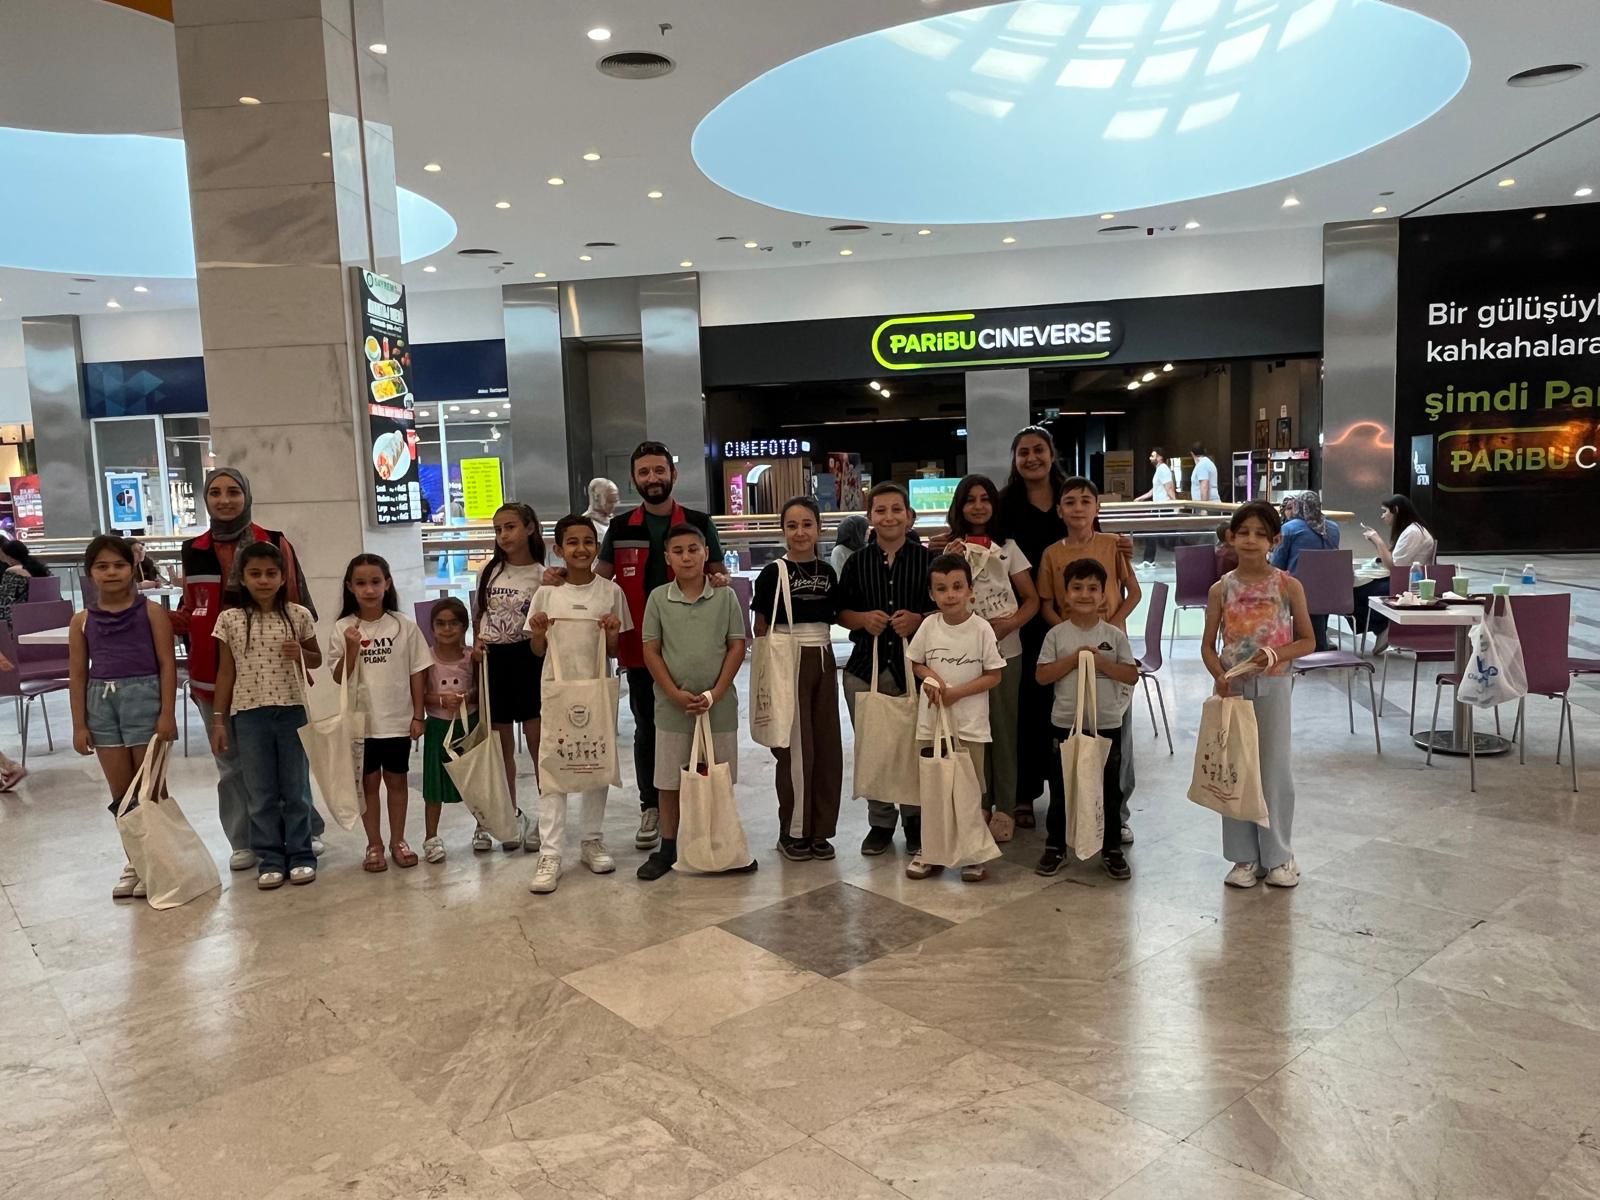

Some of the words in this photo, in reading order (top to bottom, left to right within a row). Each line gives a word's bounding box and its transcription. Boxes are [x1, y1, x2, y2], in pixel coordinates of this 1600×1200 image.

[1428, 301, 1468, 326] Bir
[978, 321, 1111, 349] CINEVERSE
[1427, 334, 1600, 362] kahkahalara
[1425, 382, 1528, 421] şimdi
[724, 438, 798, 457] CINEFOTO
[373, 637, 393, 648] MY
[363, 656, 387, 664] PLANS
